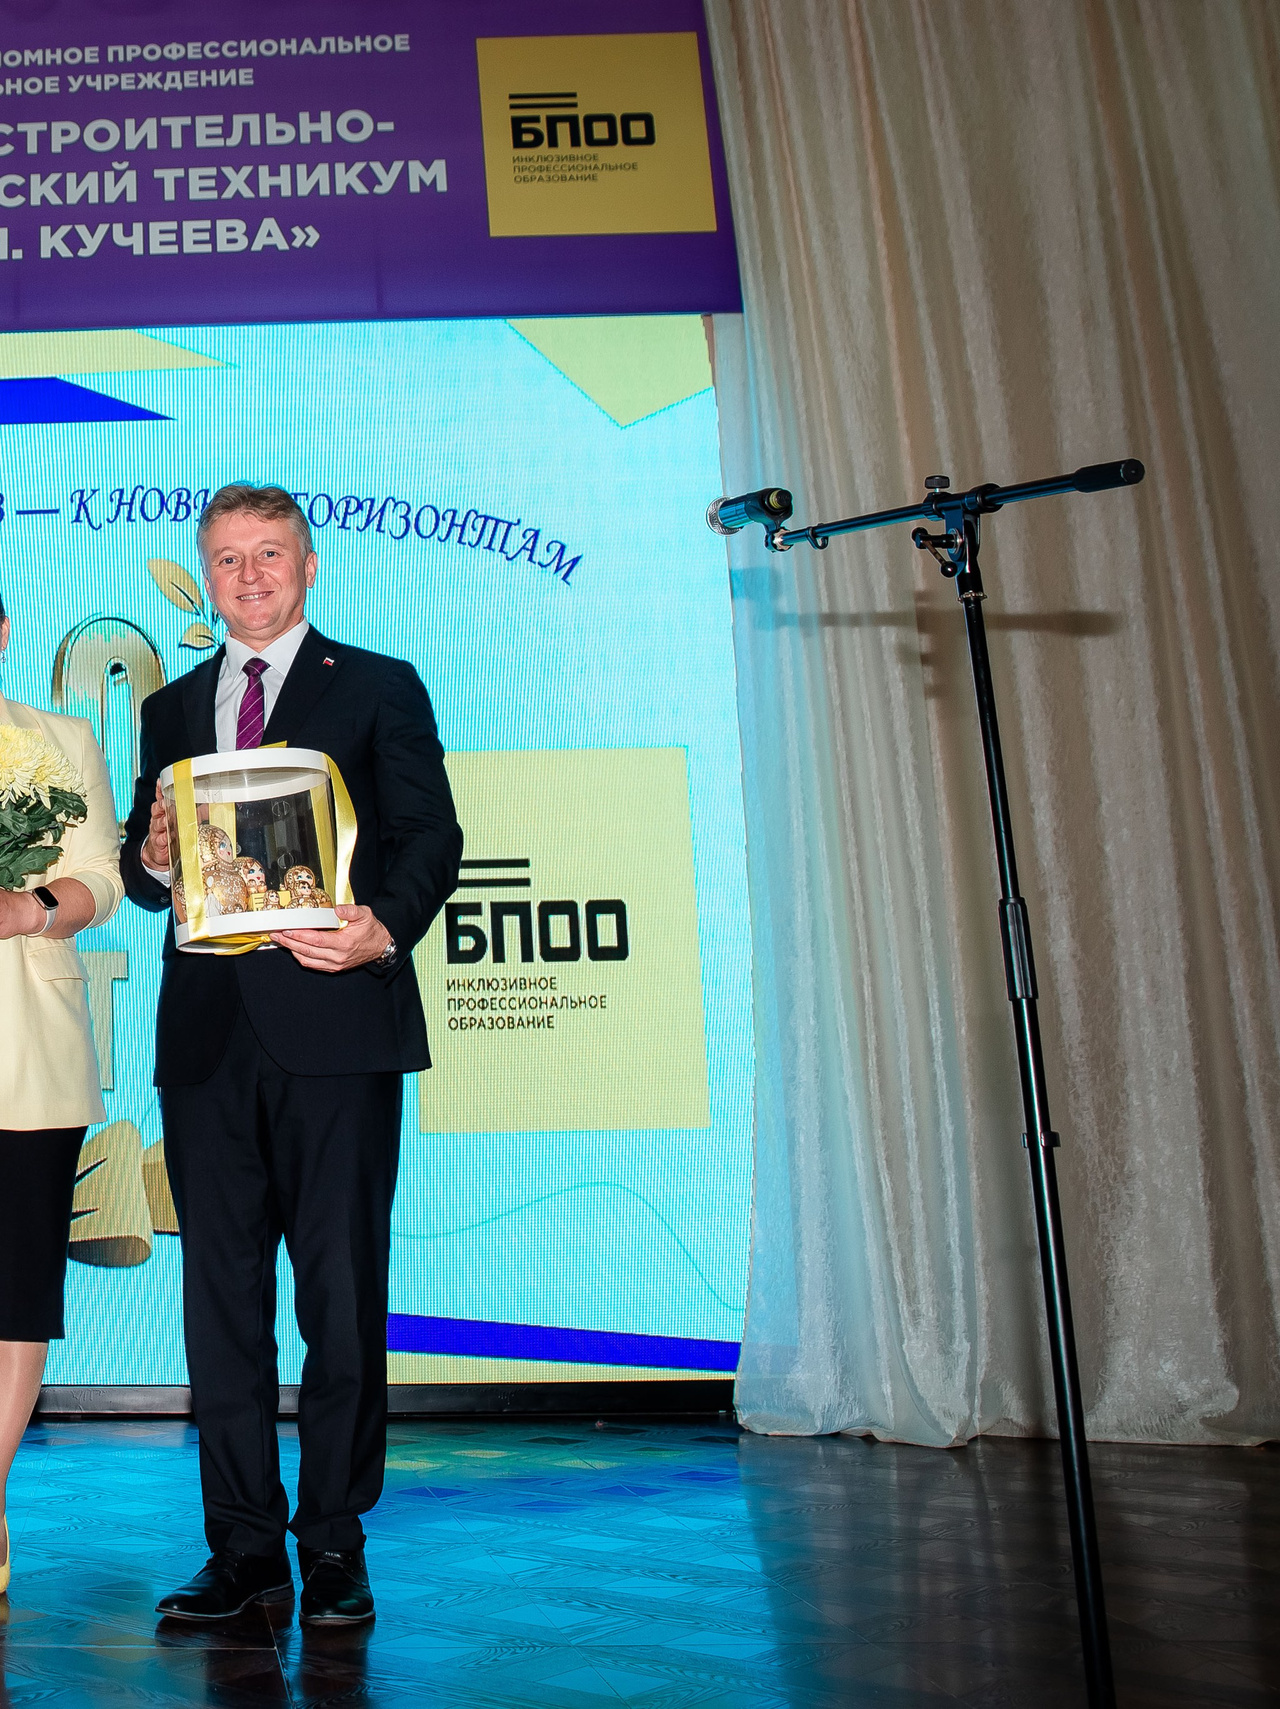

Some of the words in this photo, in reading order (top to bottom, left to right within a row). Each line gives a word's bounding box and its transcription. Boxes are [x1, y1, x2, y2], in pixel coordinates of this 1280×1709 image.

[107, 34, 410, 63] ПРОФЕССИОНАЛЬНОЕ
[67, 68, 255, 94] УЧРЕЖДЕНИЕ
[510, 112, 657, 149] БПОО
[512, 153, 600, 164] ИНКЛЮЗИВНОЕ
[513, 162, 639, 174] ПРОФЕССИОНАЛЬНОЕ
[153, 159, 448, 203] ТЕХНИКУМ
[513, 173, 598, 184] ОБРАЗОВАНИЕ
[40, 217, 322, 260] КУЧЕЕВА»
[70, 488, 103, 531] К
[106, 484, 210, 523] НОВ
[290, 491, 584, 587] ОРИЗОНТАМ
[445, 899, 630, 965] БПОО
[446, 976, 558, 992] ИНКЛЮЗИВНОЕ
[447, 994, 608, 1012] ПРОФЕССИОНАЛЬНОЕ
[447, 1015, 555, 1031] ОБРАЗОВАНИЕ
